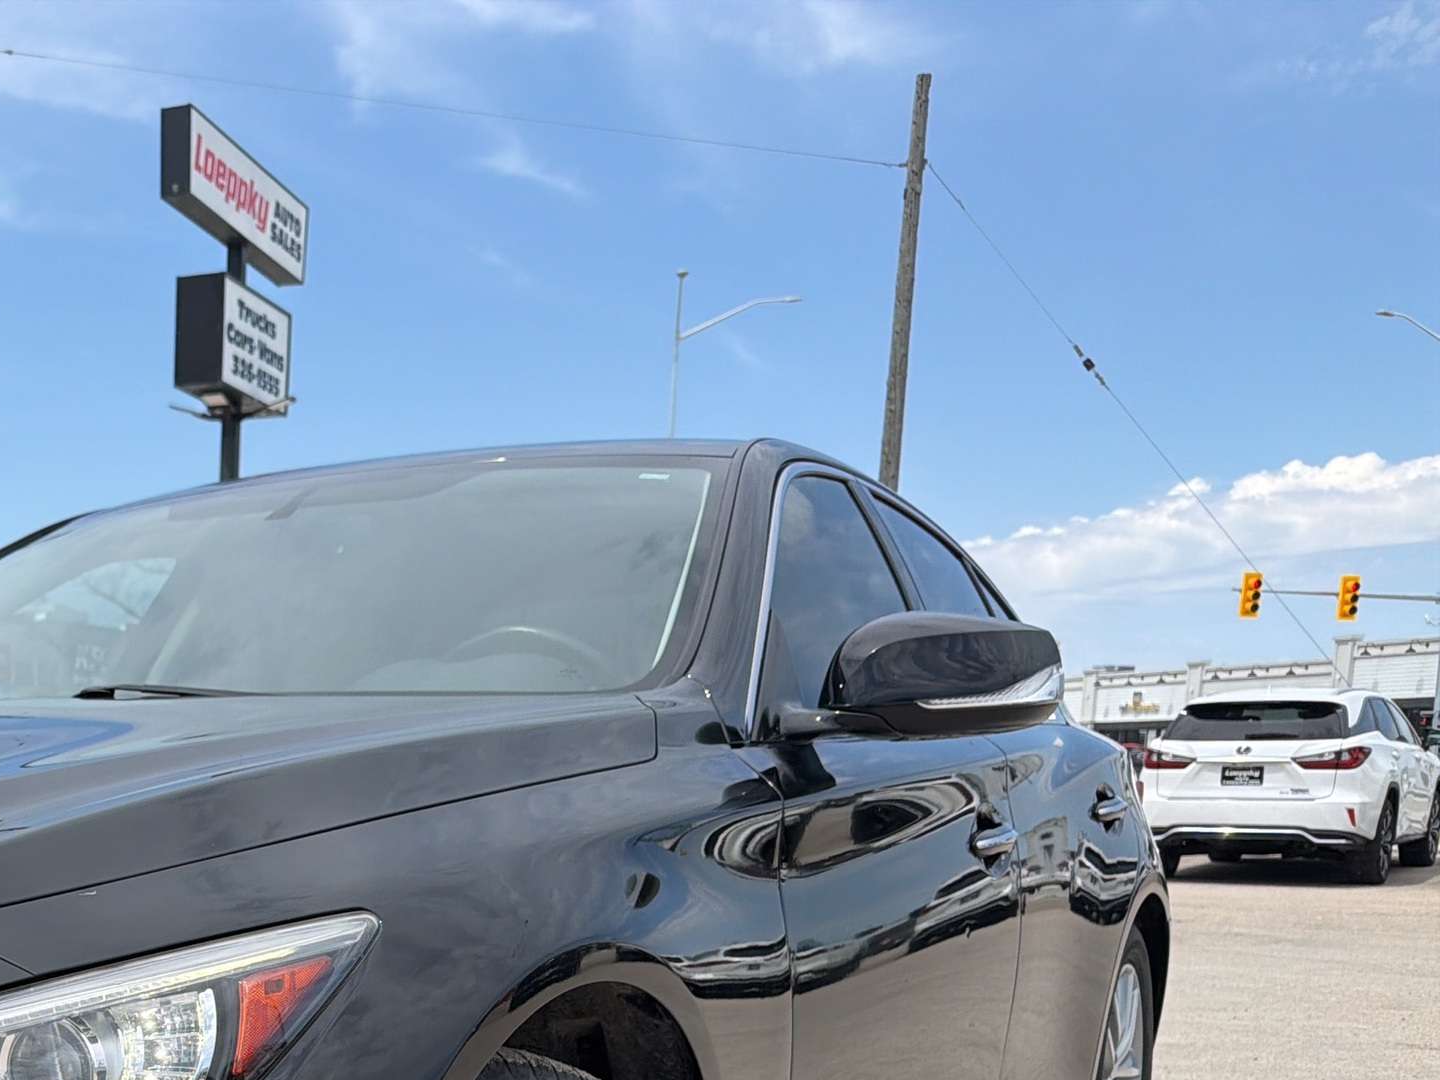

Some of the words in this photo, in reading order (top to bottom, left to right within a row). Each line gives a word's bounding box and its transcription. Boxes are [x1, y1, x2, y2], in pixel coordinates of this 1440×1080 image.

[194, 133, 270, 234] Loeppky
[272, 200, 302, 239] AUTO
[269, 221, 302, 264] SALES
[237, 299, 277, 340] Trucks
